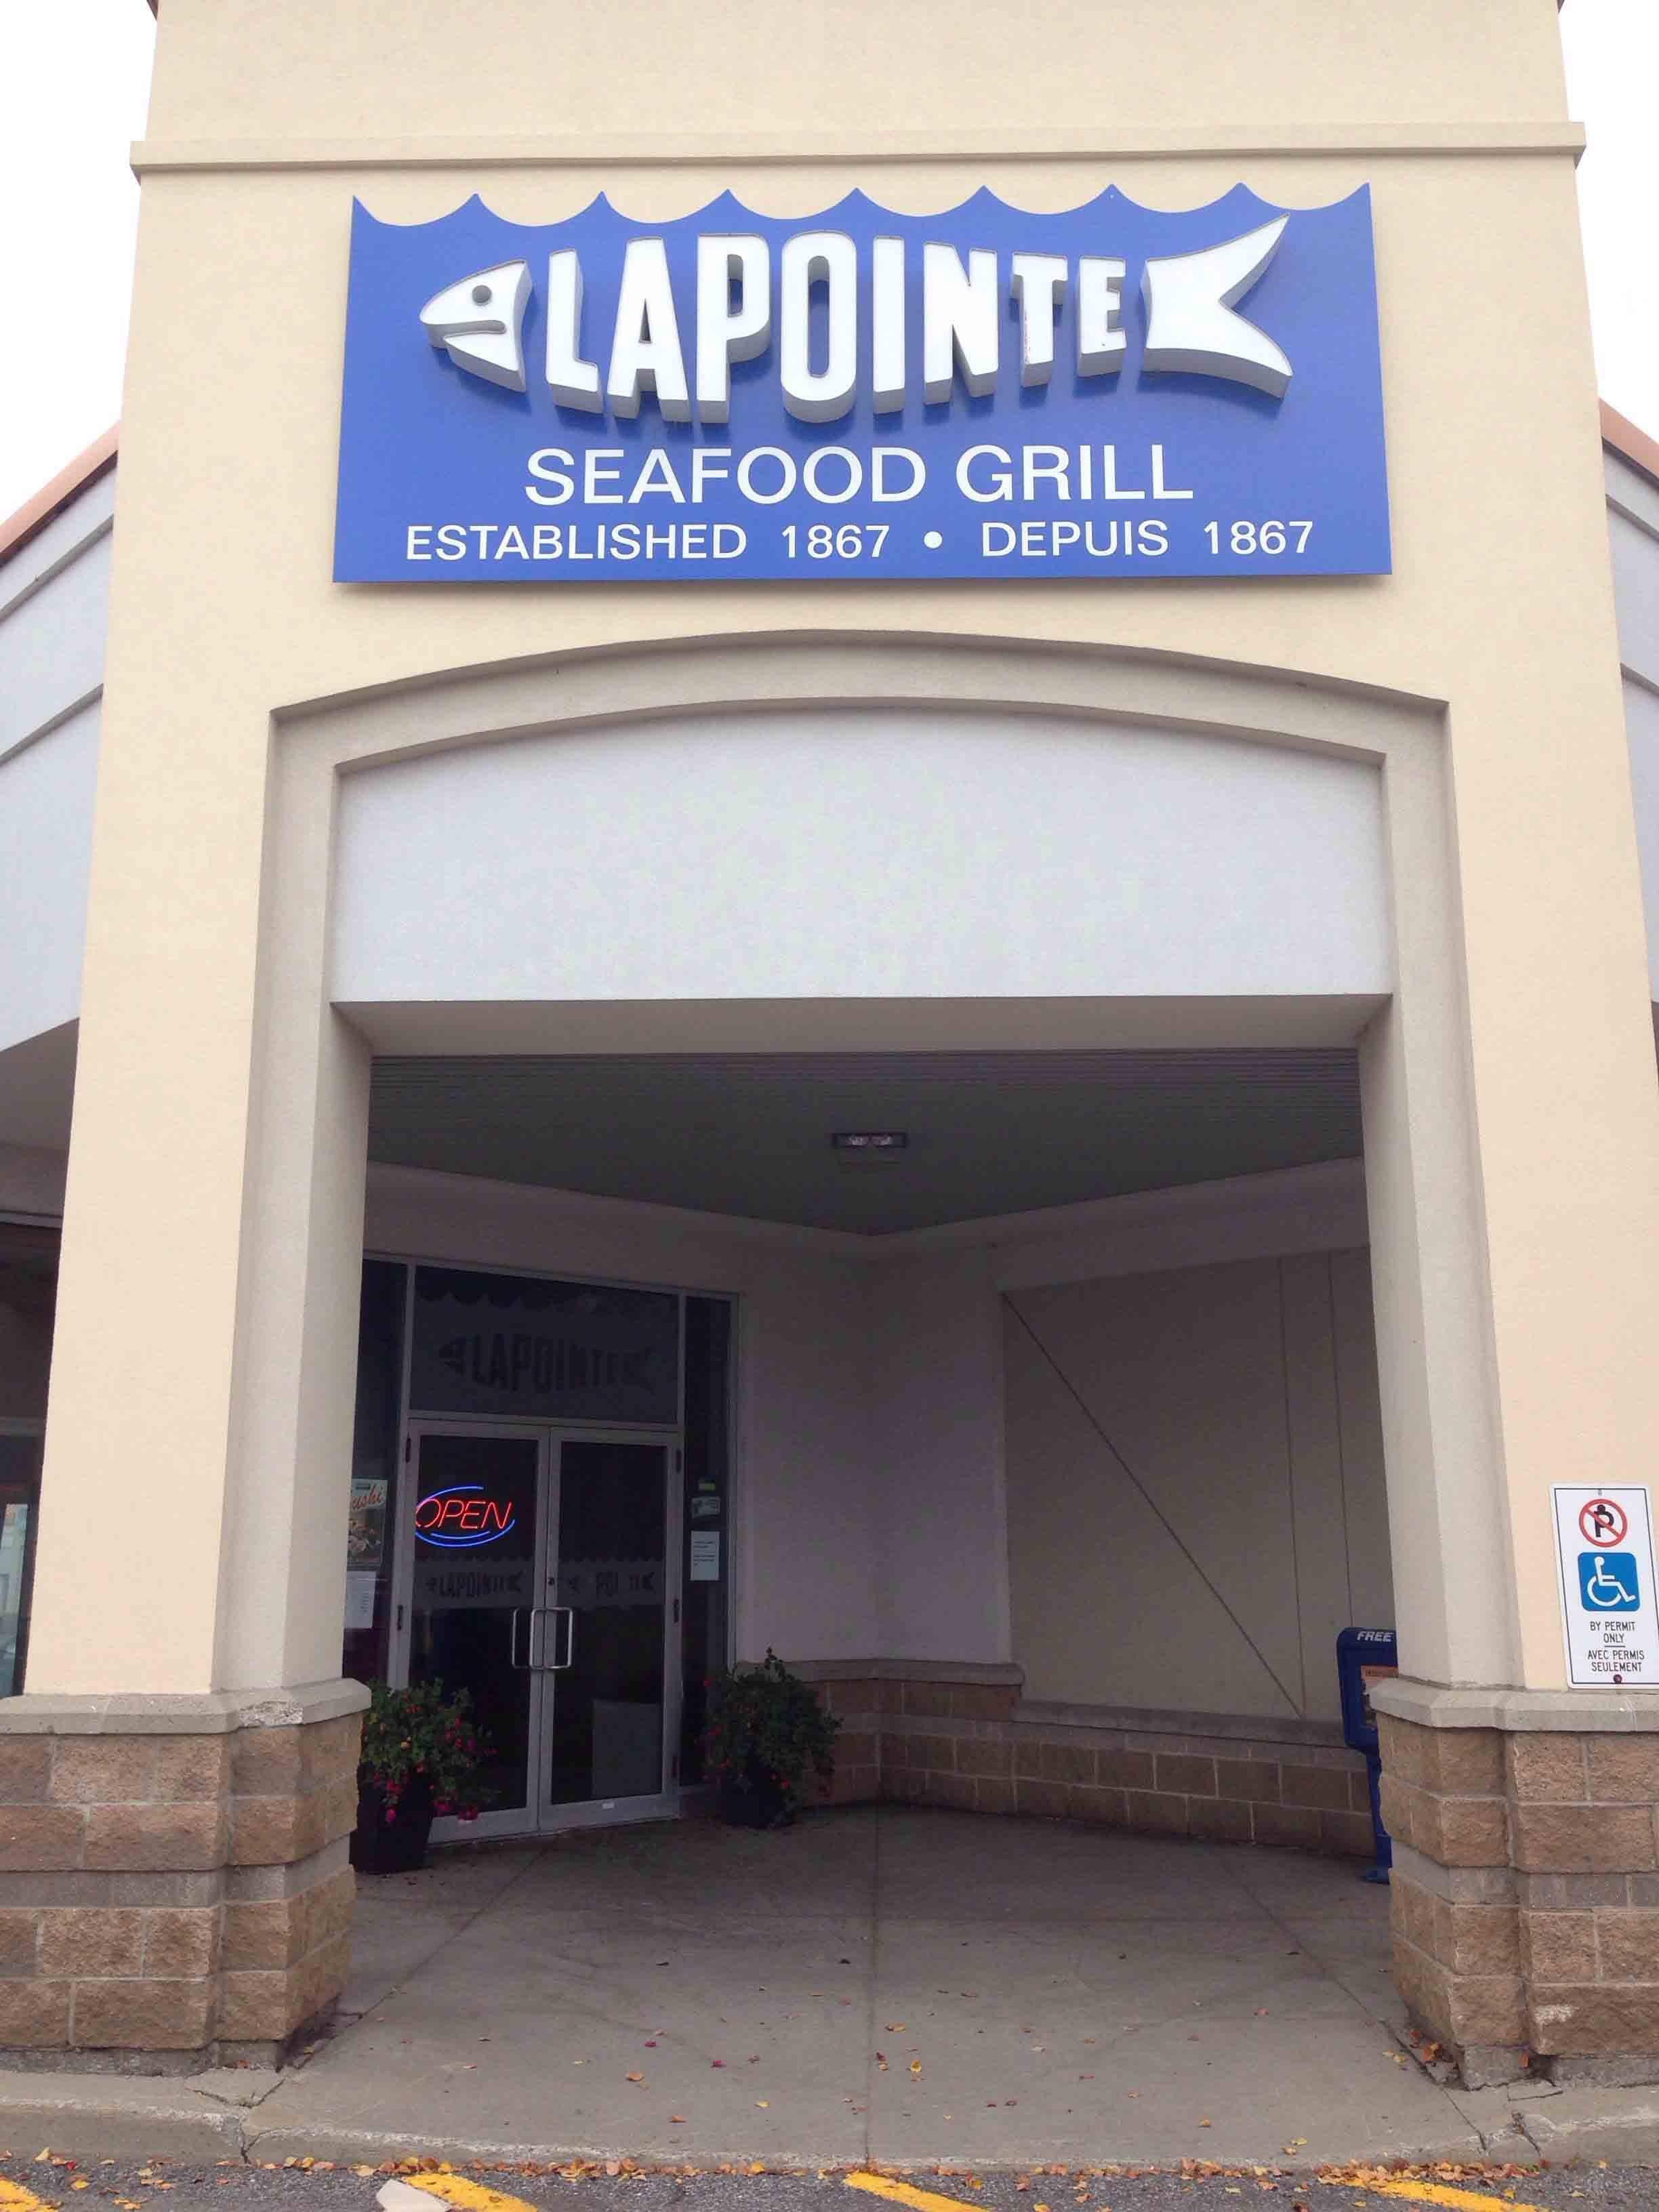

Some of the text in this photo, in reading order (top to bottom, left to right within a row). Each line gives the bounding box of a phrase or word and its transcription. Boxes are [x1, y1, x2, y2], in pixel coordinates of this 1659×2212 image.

[545, 230, 1127, 423] LAPOINTE
[525, 444, 1193, 506] SEAFOOD GRILL
[407, 520, 1313, 560] ESTABLISHED 1867 DEPUIS 1867
[415, 1498, 512, 1530] OPEN
[1590, 1620, 1636, 1632] BY PERMIT
[1357, 1631, 1394, 1643] FREE
[1603, 1633, 1624, 1643] ONLY
[1587, 1650, 1645, 1660] AVEC PERMIS
[1591, 1662, 1642, 1672] SEULEMENT
